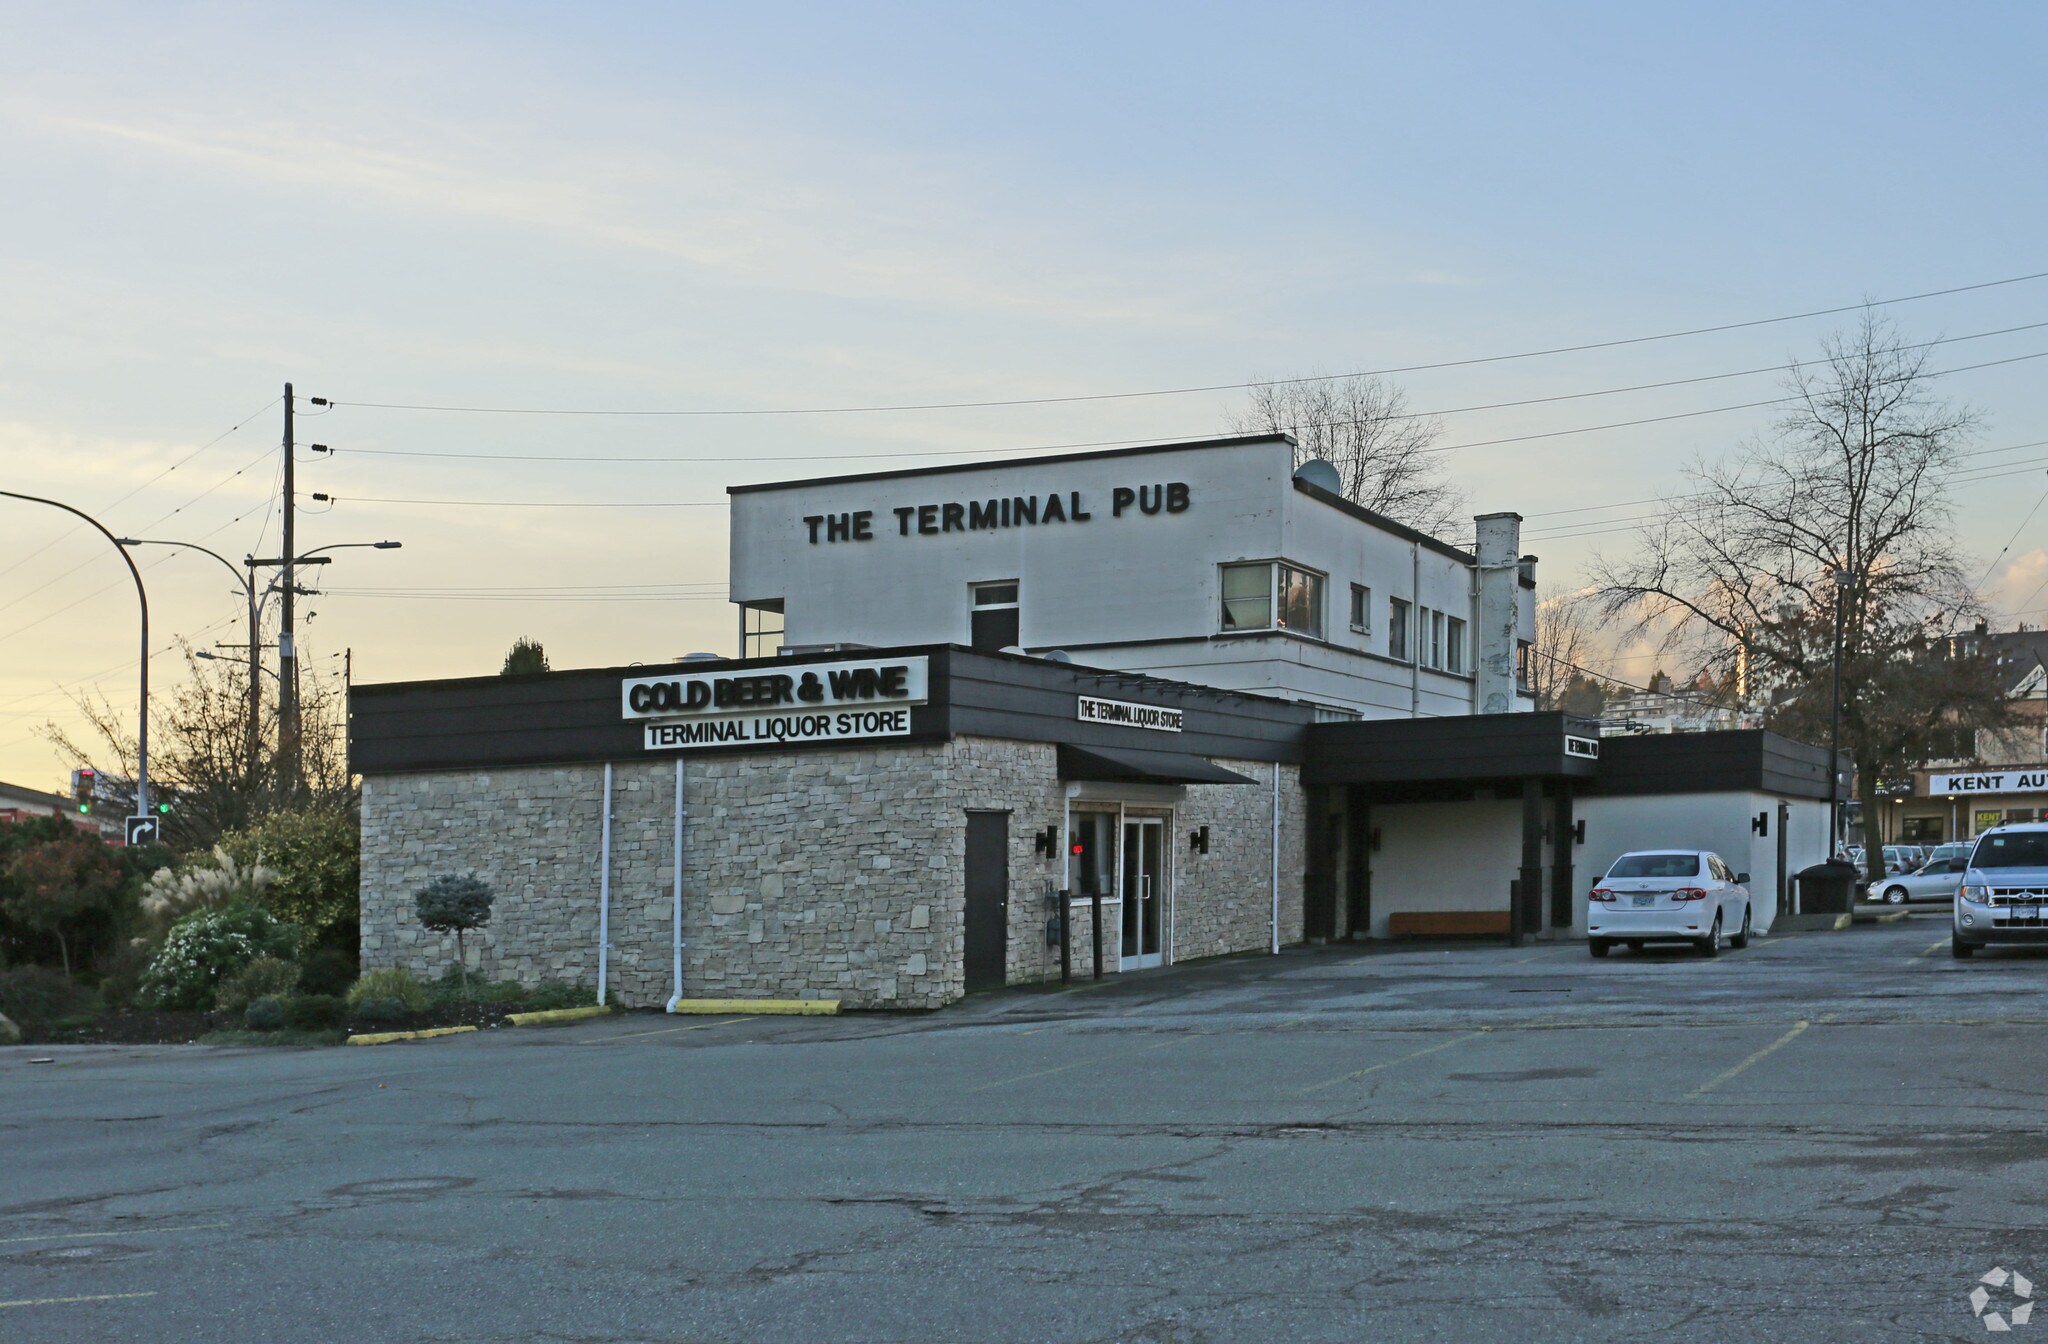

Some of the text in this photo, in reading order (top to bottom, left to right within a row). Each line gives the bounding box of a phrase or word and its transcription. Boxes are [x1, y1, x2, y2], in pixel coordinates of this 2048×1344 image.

[803, 482, 1190, 544] THE TERMINAL PUB
[629, 666, 909, 713] COLD BEER & WINE
[648, 710, 907, 746] TERMINAL LIQUOR STORE
[1080, 700, 1182, 728] THE TERMINAL LIQUOR STORE
[1949, 776, 2004, 790] KENT
[1977, 812, 2000, 821] KENT
